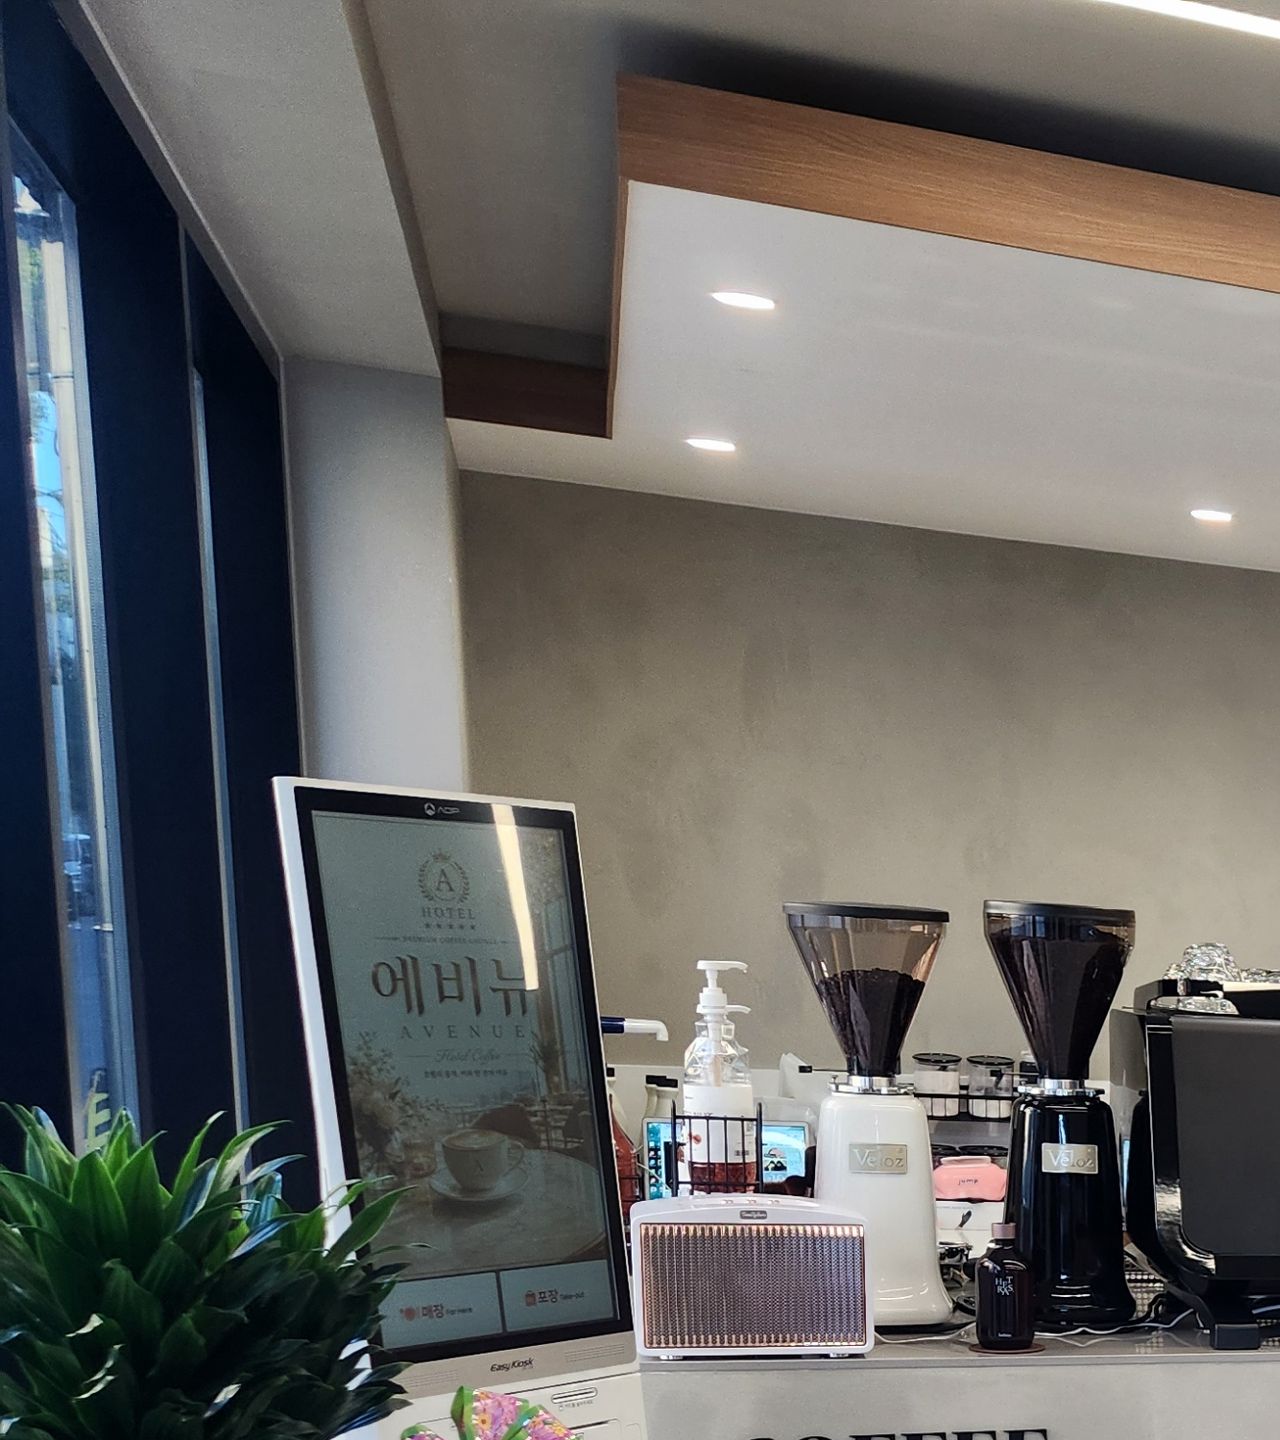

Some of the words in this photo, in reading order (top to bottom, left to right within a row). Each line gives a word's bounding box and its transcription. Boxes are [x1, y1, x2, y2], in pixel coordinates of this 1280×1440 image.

[421, 906, 476, 921] HOTEL
[371, 954, 539, 1017] 에비뉴
[401, 1024, 526, 1040] AVENUE
[853, 1149, 905, 1168] Veloz
[1048, 1149, 1095, 1168] Veloz
[538, 1288, 558, 1304] 포장
[421, 1303, 445, 1319] 매장
[490, 1361, 511, 1373] Easy
[511, 1357, 534, 1369] Kiosk
